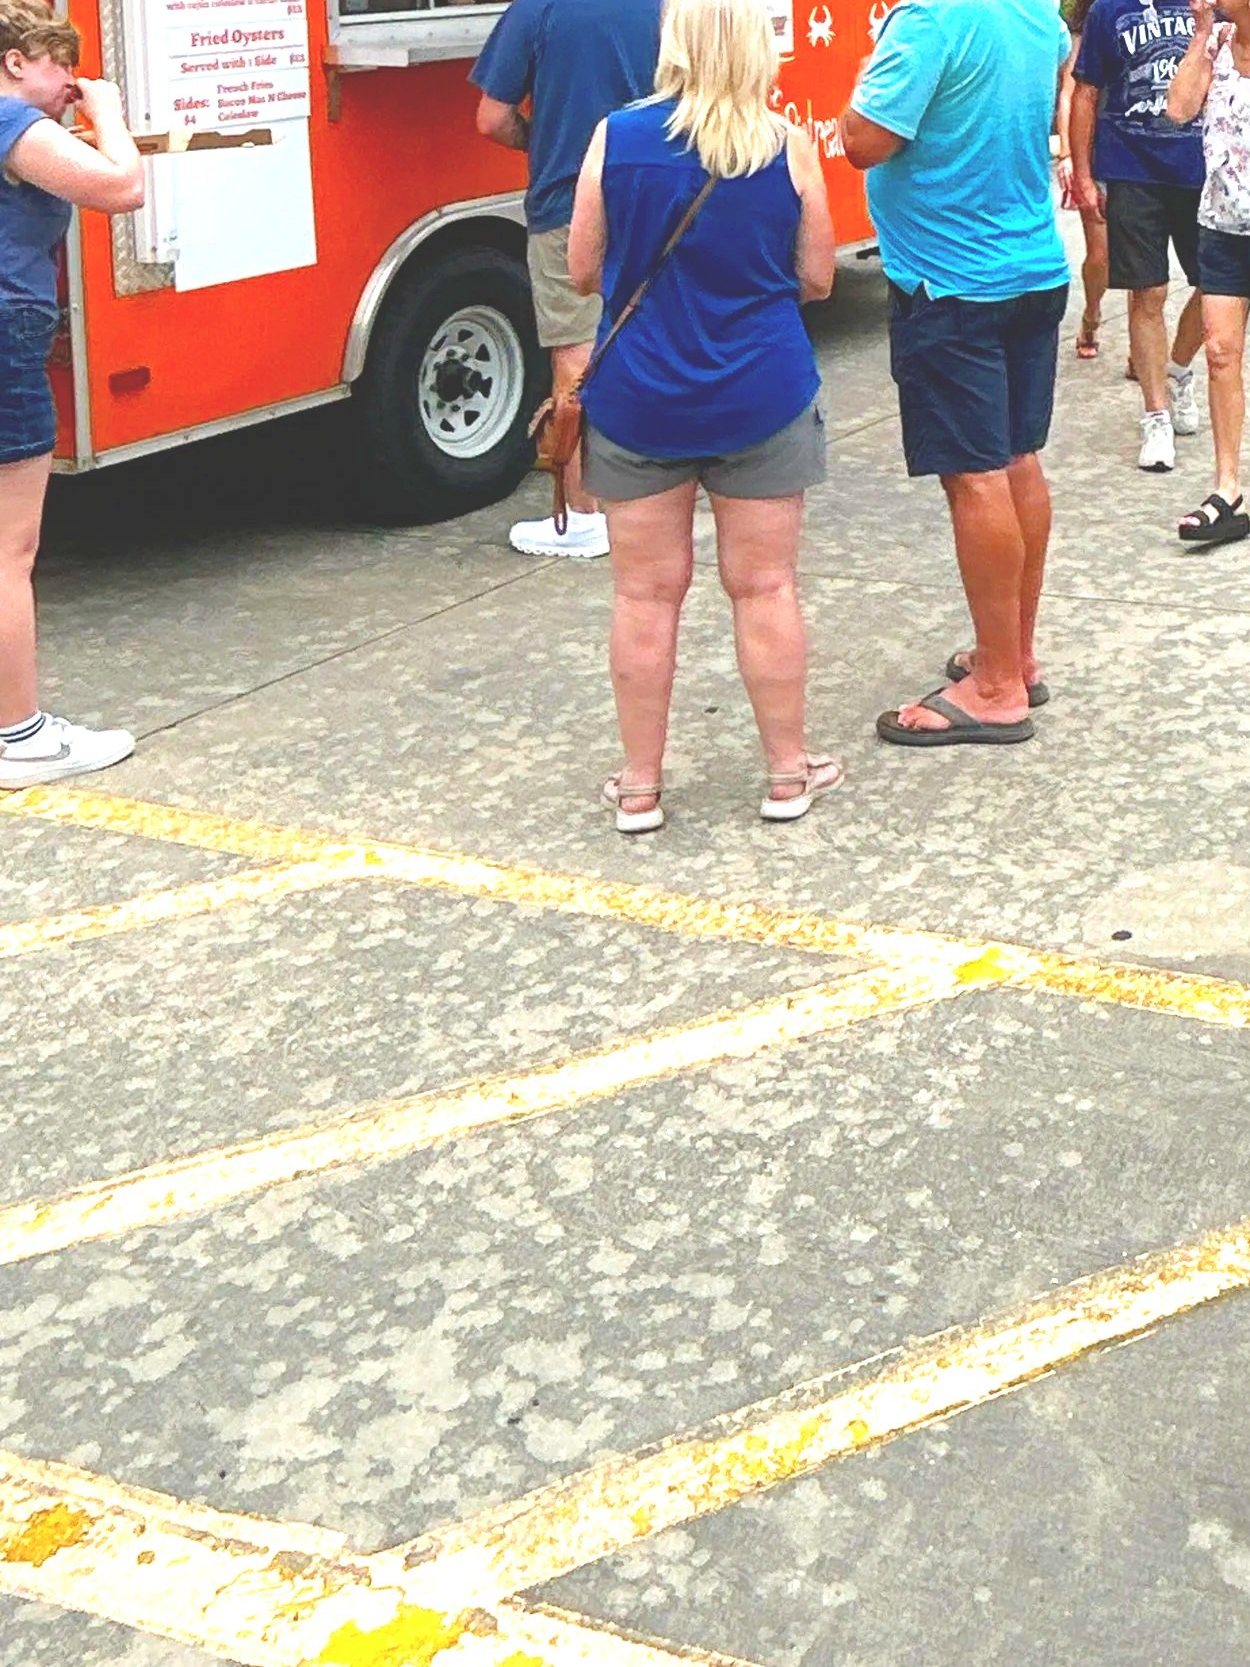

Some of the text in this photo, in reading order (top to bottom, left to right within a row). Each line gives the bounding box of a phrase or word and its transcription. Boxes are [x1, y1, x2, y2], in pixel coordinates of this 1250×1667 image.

[191, 29, 284, 47] Fried Oysters
[1122, 16, 1196, 54] VINTAG
[181, 59, 219, 73] Served
[1152, 56, 1179, 83] 196
[174, 97, 209, 111] Sides:
